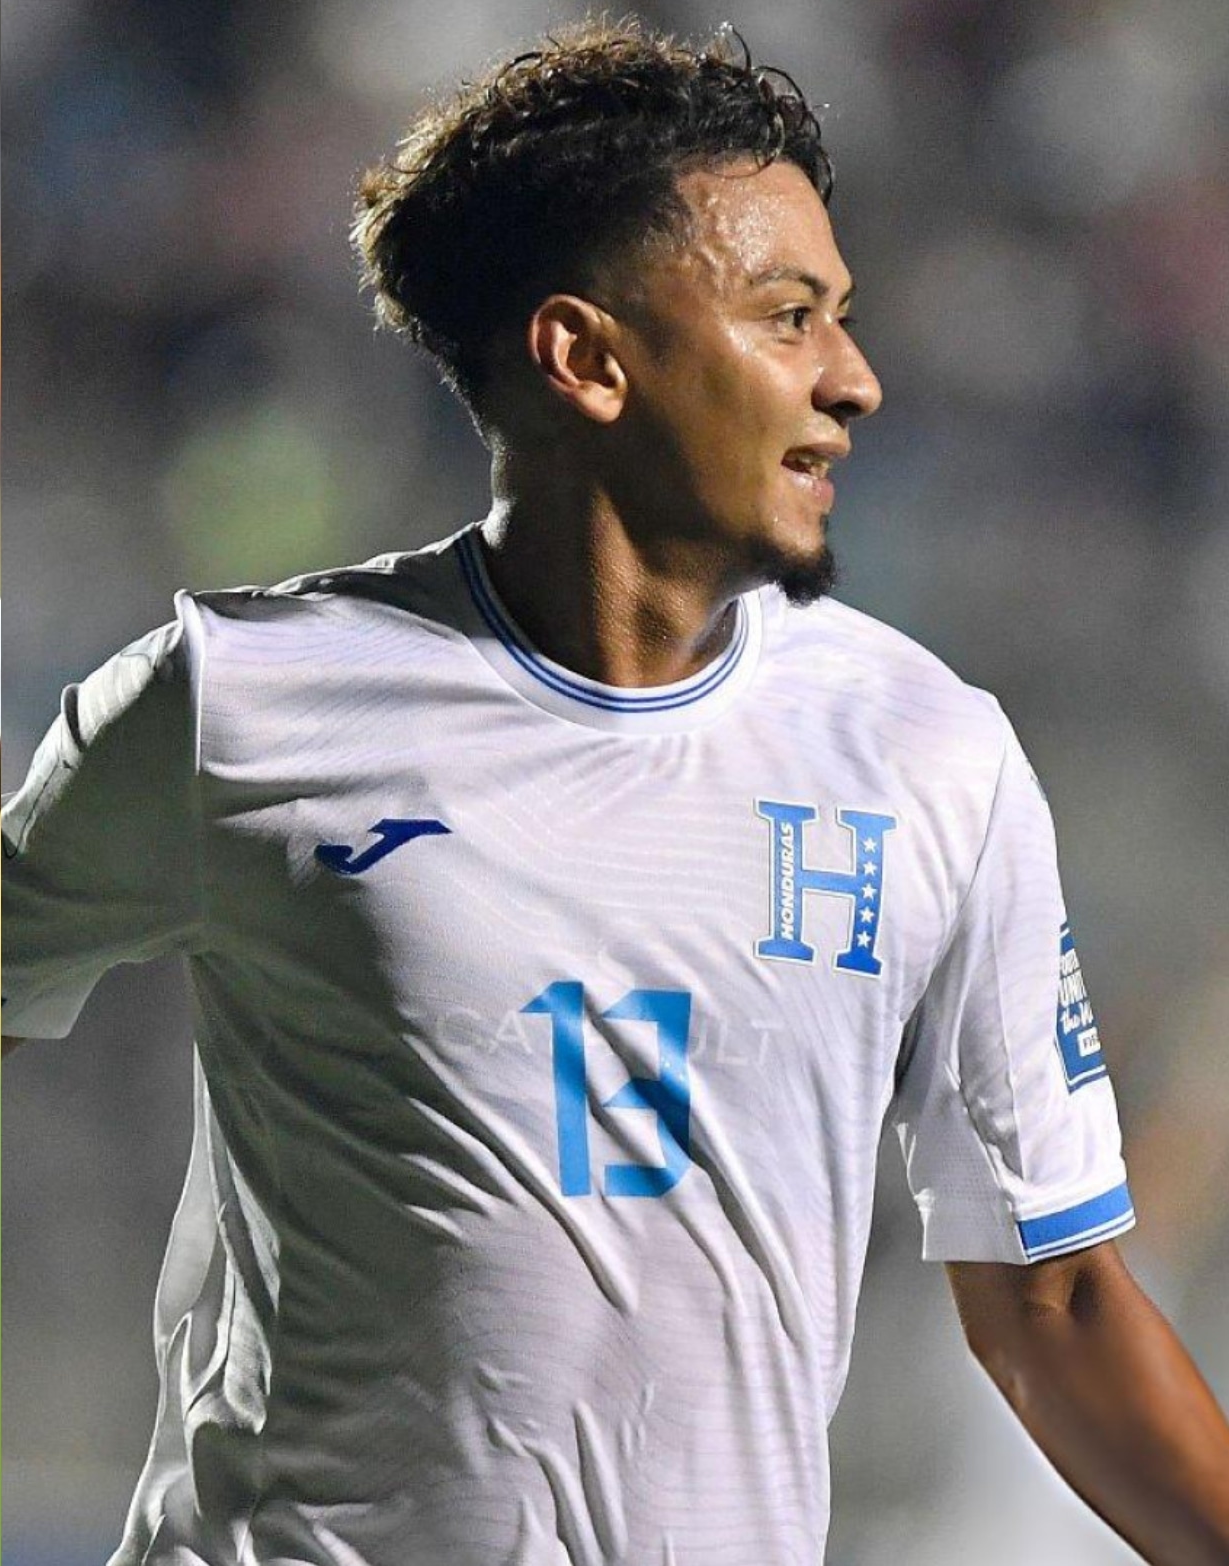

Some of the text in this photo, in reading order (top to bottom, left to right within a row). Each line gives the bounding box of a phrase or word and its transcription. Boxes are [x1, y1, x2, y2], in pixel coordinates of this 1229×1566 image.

[754, 799, 898, 977] H
[780, 821, 795, 941] HONDURAS
[519, 980, 692, 1198] 13
